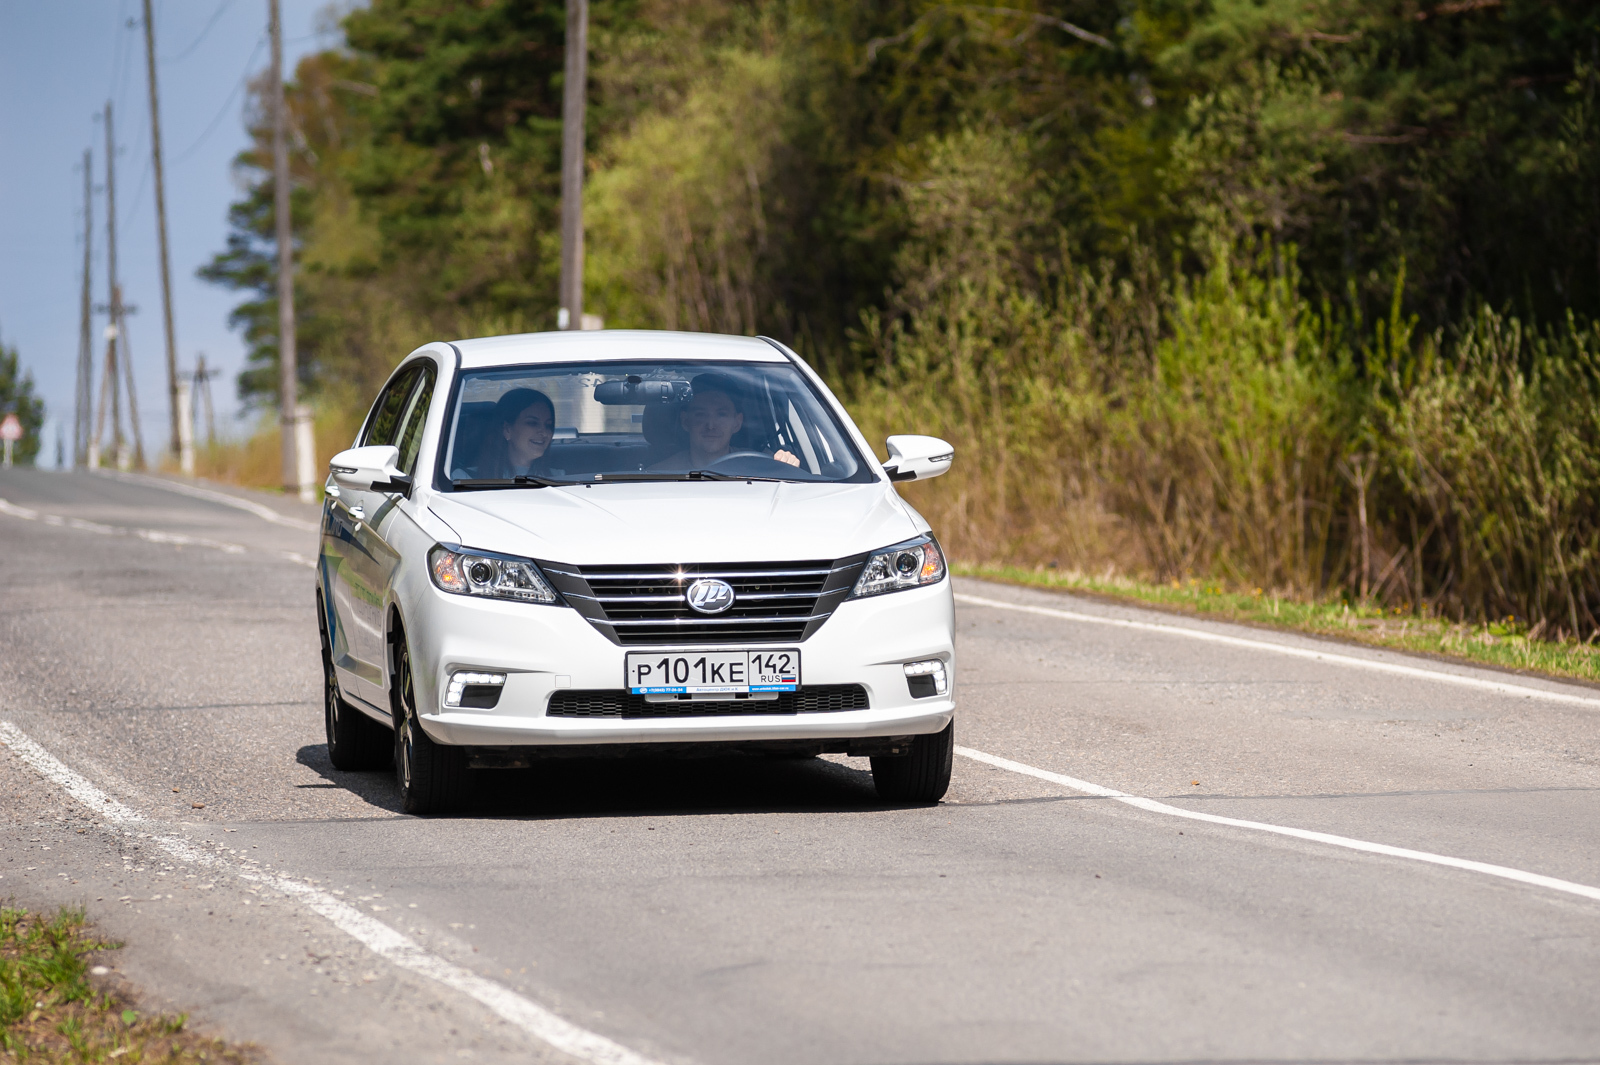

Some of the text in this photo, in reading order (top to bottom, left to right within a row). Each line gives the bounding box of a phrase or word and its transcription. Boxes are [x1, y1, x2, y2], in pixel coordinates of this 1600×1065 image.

[637, 653, 791, 685] Р101КЕ 142
[761, 675, 781, 683] RUS
